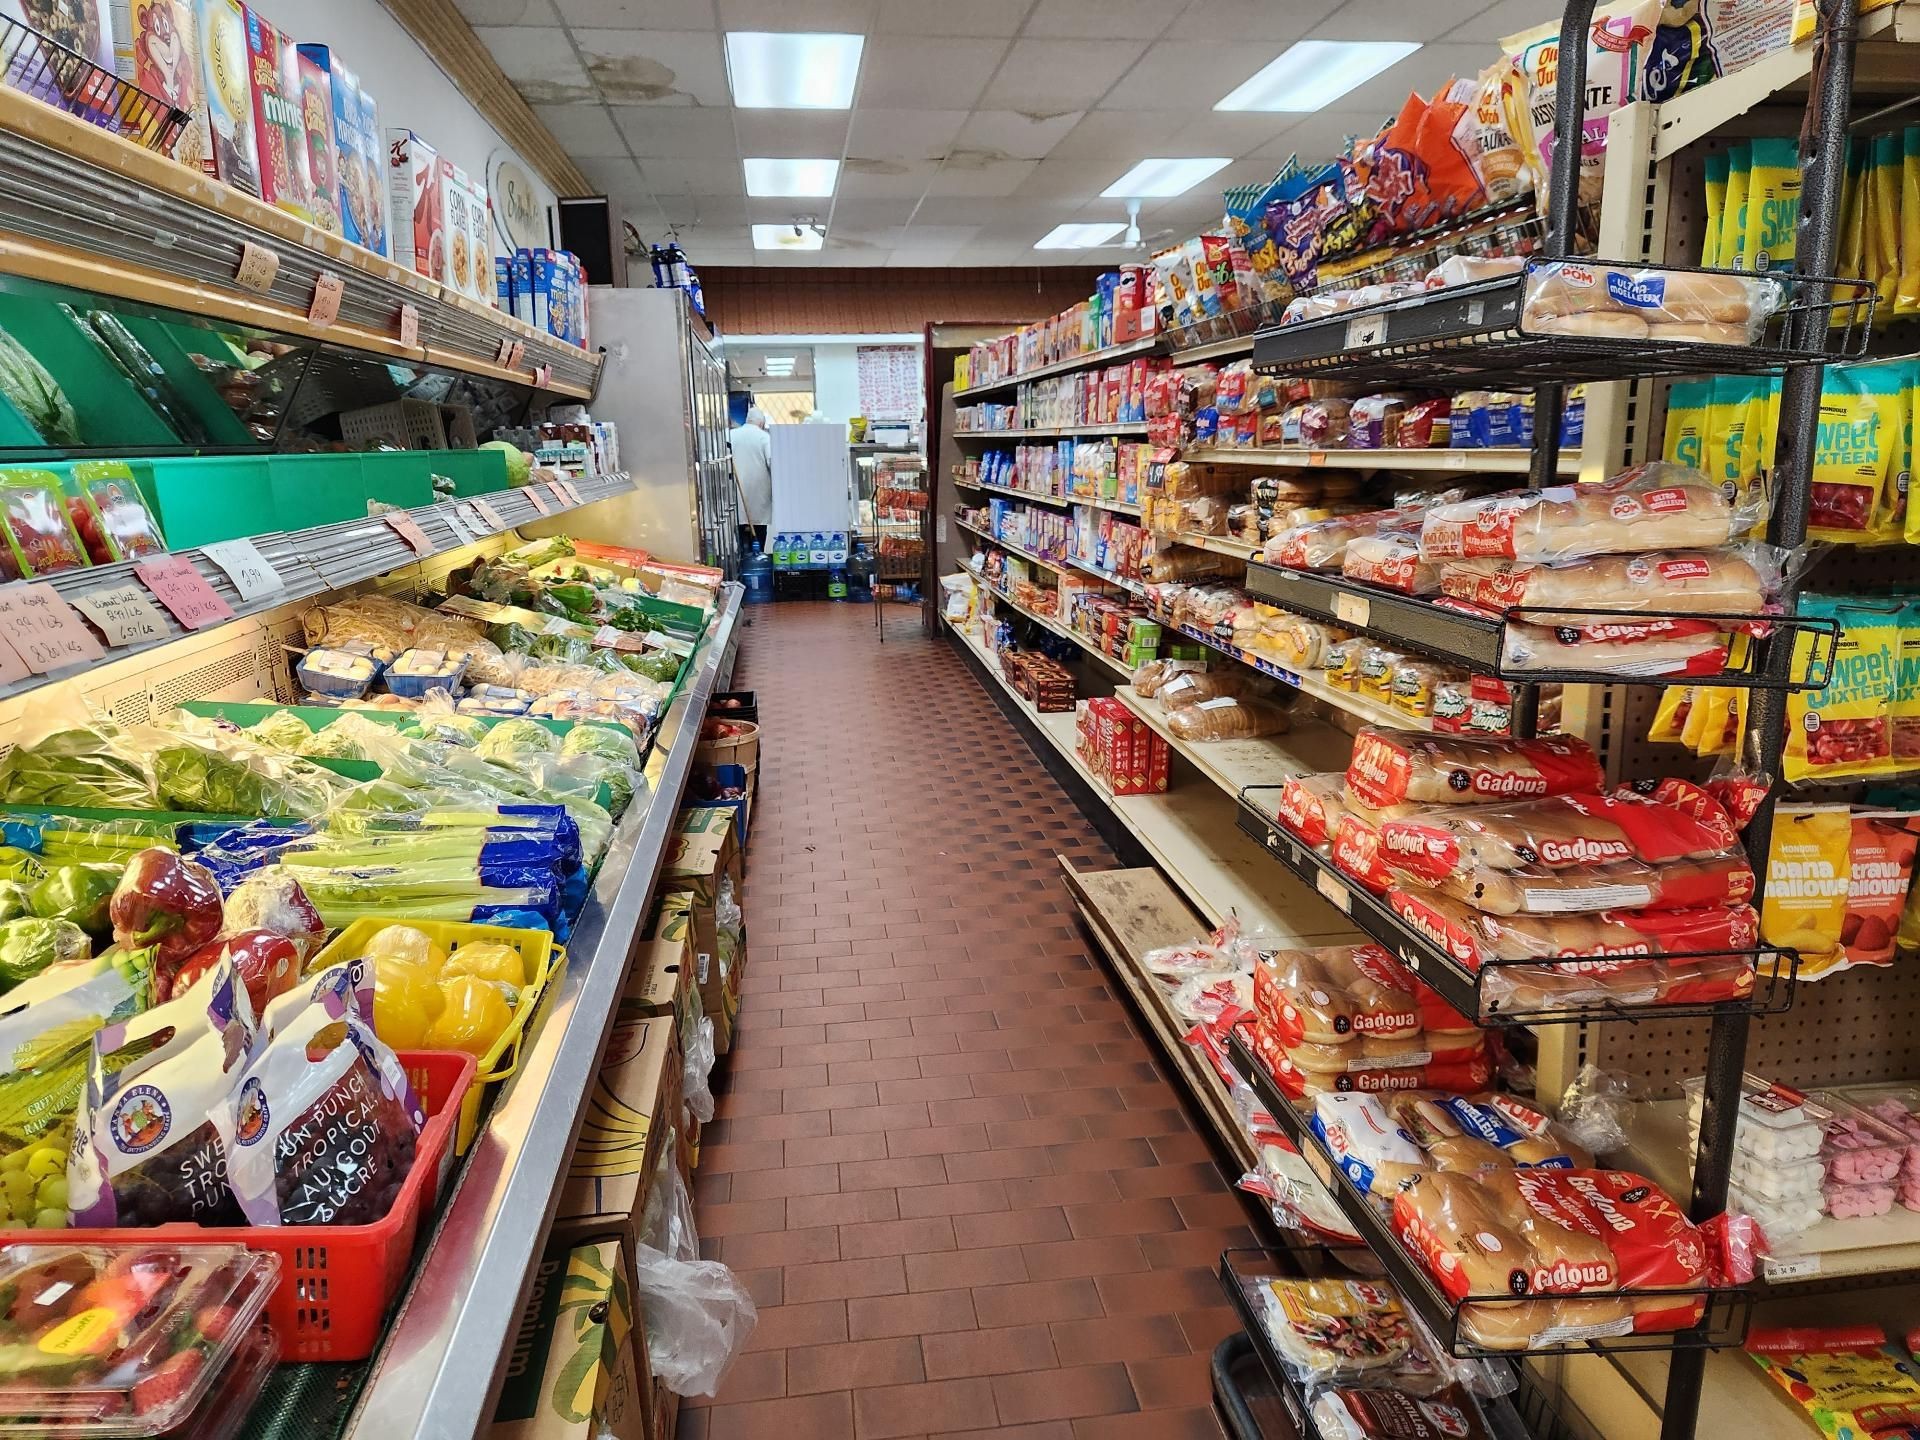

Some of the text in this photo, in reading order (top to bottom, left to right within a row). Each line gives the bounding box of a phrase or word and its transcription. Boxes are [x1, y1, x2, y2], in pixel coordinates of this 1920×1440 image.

[1562, 268, 1594, 284] POM
[1816, 450, 1879, 465] XTEEN
[1613, 504, 1641, 517] POM
[1383, 557, 1400, 569] POM
[1476, 772, 1548, 793] Gadoua
[1386, 828, 1425, 855] Gadoua
[1542, 838, 1628, 861] Gadoua
[1771, 860, 1834, 878] bana
[1852, 862, 1900, 880] traw
[1849, 878, 1909, 896] allows
[1403, 905, 1449, 951] Gadoua
[1353, 1012, 1415, 1030] Gadoua
[1359, 1074, 1418, 1090] Gadoua
[132, 1087, 163, 1102] ELENA
[313, 1070, 366, 1127] PUNCH
[180, 1136, 225, 1179] SWE
[303, 1120, 382, 1202] AU GOÛT
[184, 1160, 228, 1199] TRO
[321, 1154, 379, 1222] SUCRÉ
[192, 1183, 233, 1218] PUN
[1566, 1175, 1636, 1232] Gadoua
